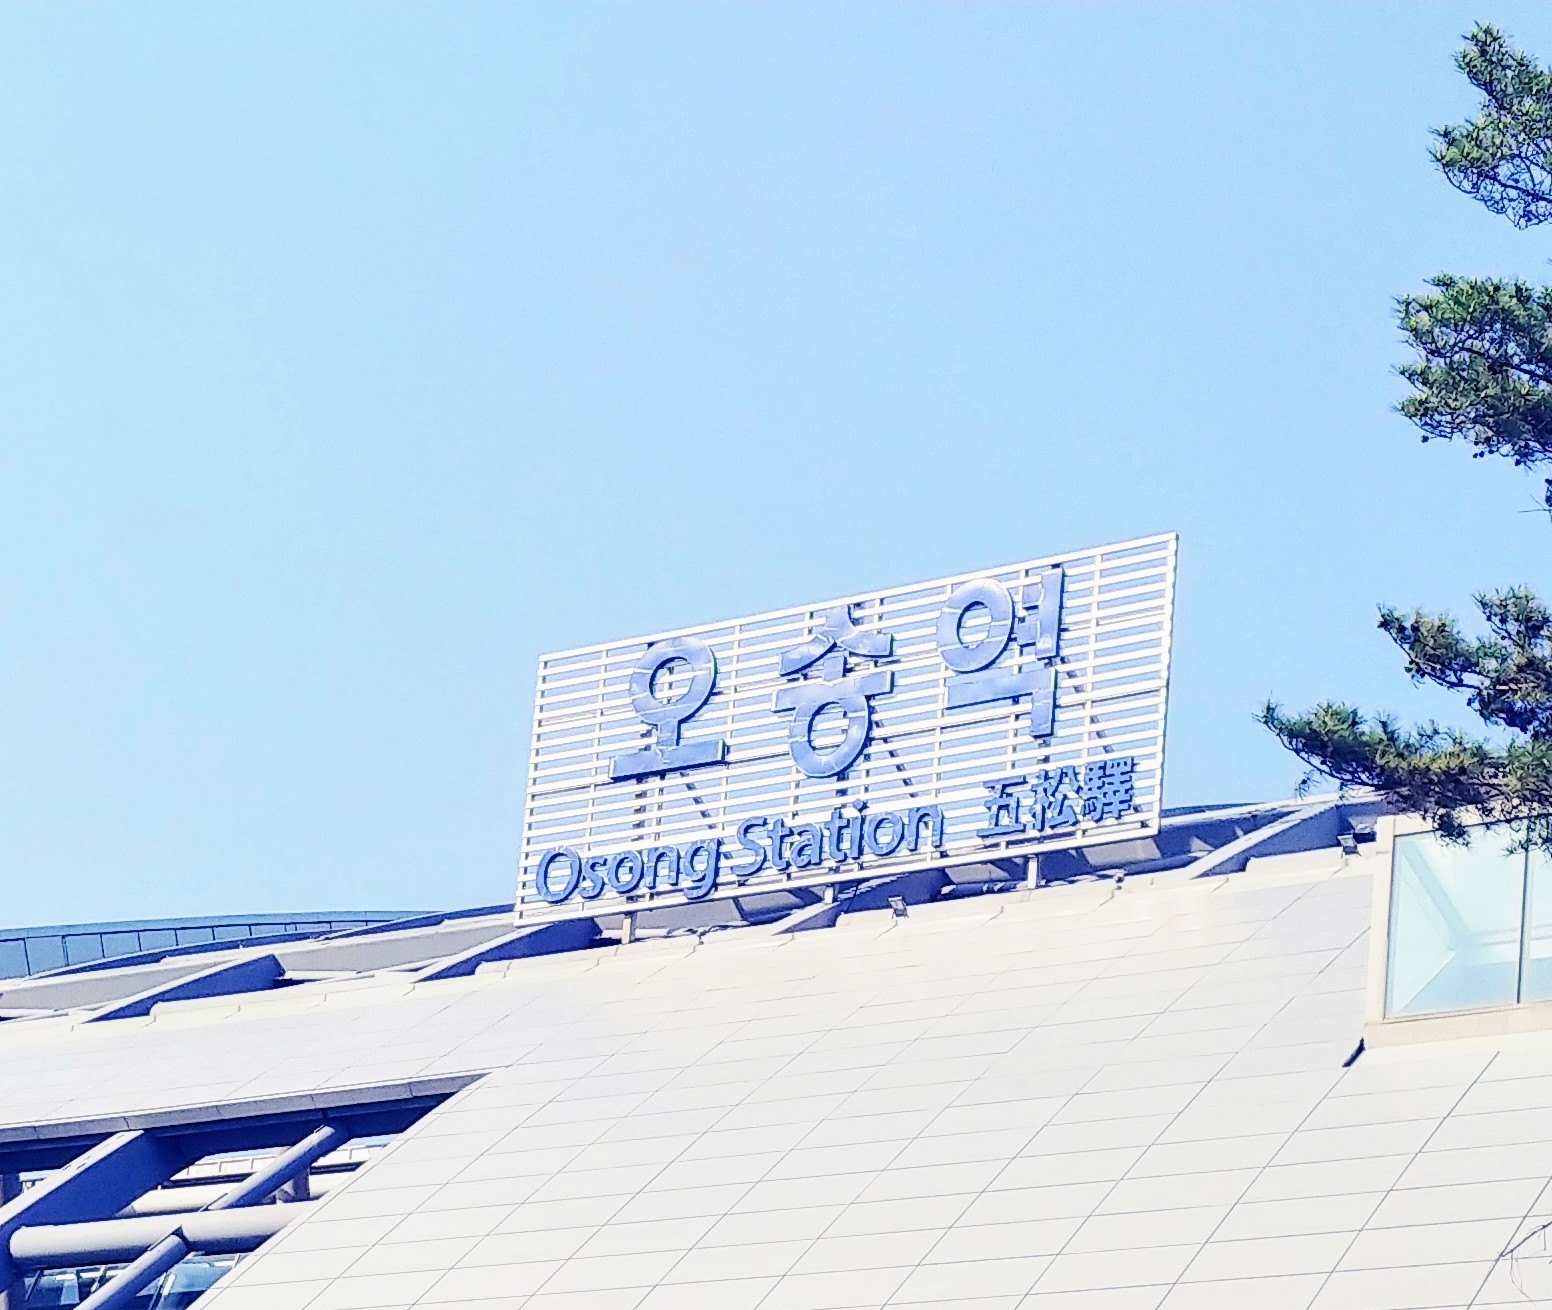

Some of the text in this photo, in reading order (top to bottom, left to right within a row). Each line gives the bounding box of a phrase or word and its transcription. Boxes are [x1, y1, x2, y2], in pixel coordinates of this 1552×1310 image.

[609, 566, 1066, 780] 오송역
[535, 799, 945, 903] Osong Station
